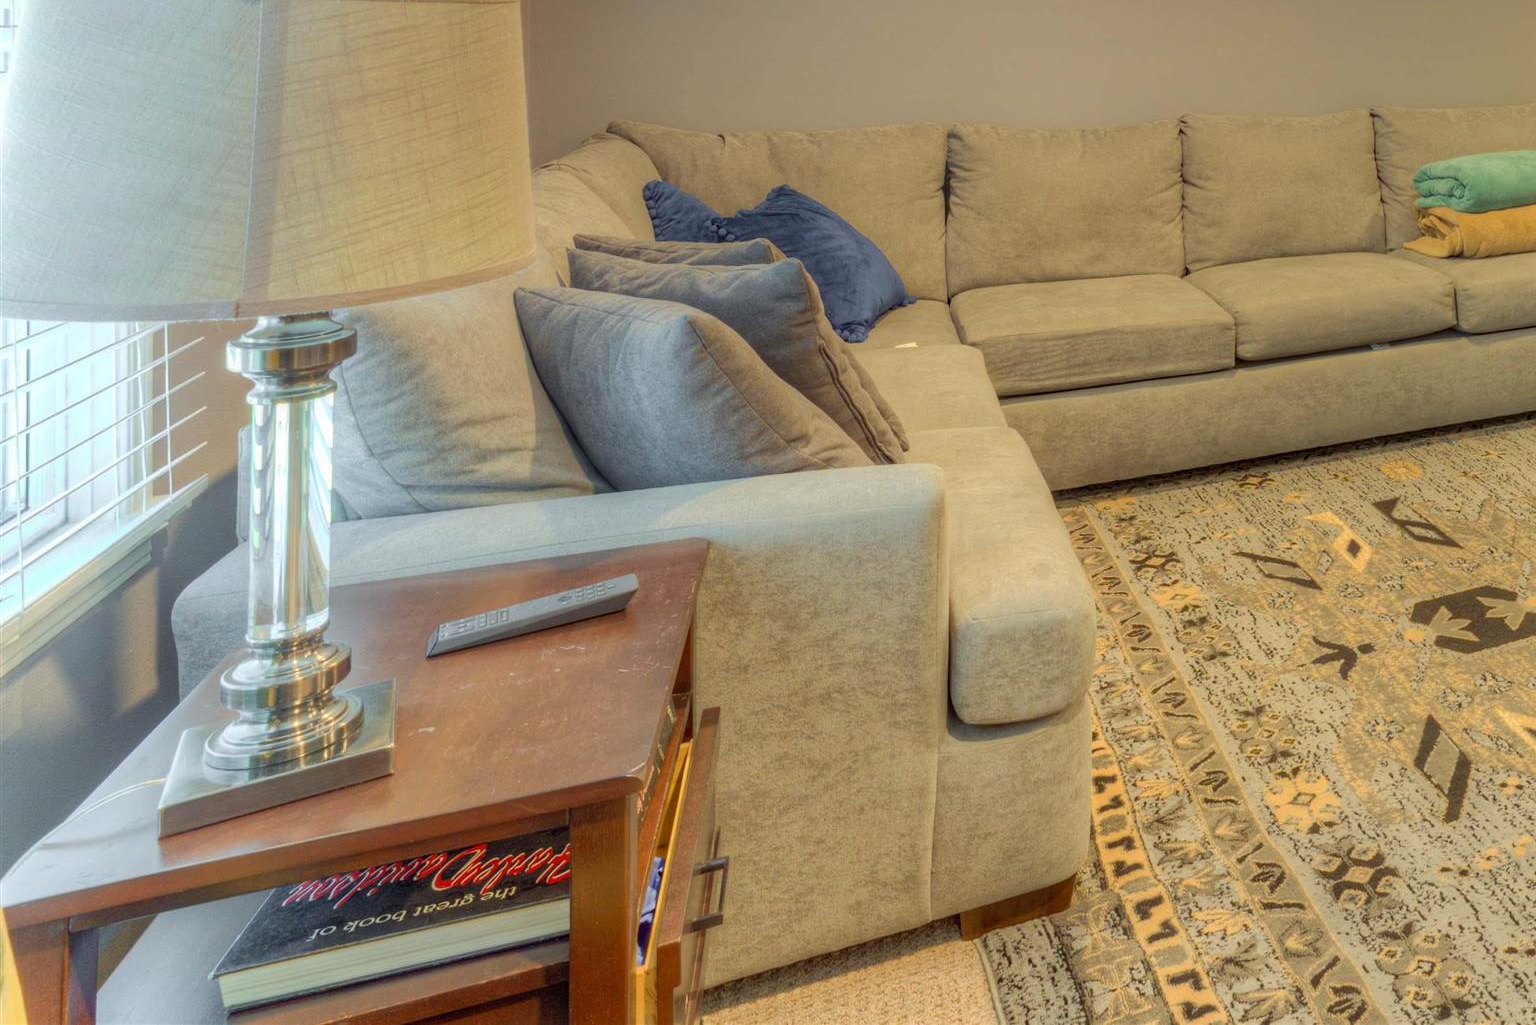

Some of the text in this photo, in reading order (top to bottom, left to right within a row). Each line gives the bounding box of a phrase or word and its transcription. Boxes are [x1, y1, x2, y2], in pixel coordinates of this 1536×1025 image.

[453, 842, 571, 896] Harley
[305, 885, 517, 943] the great book of
